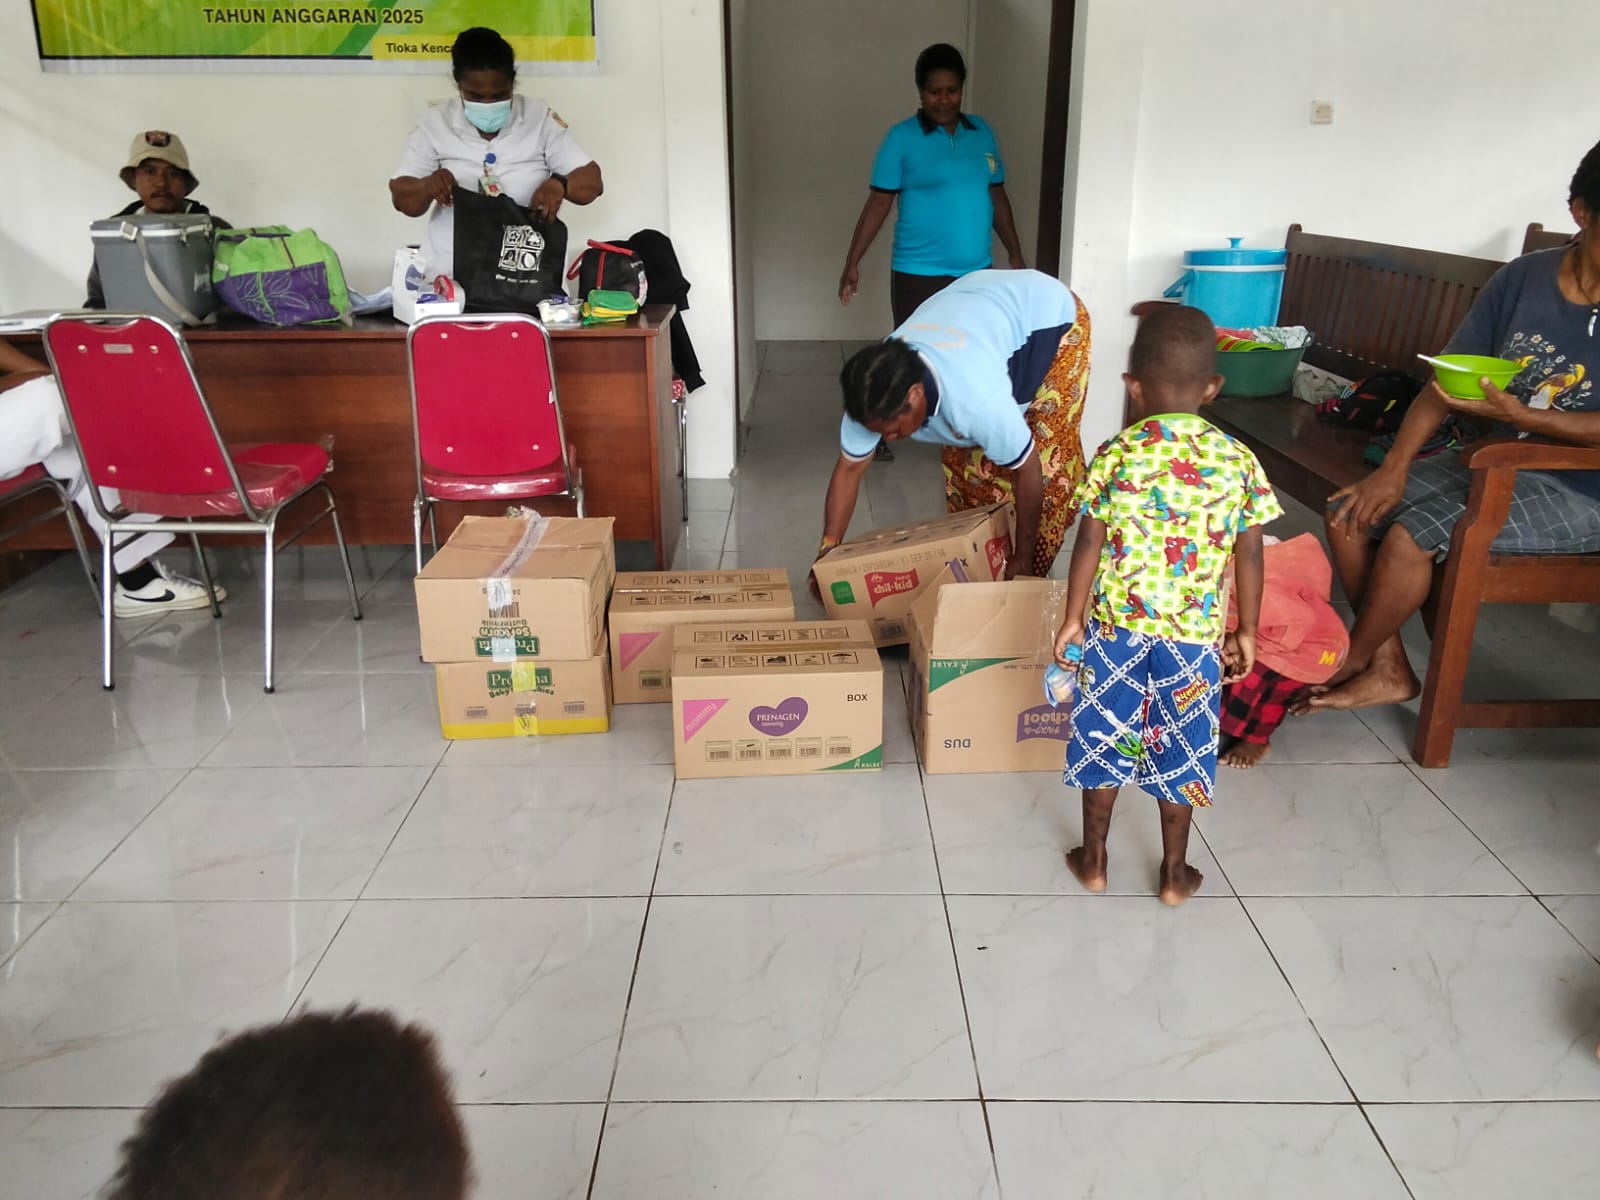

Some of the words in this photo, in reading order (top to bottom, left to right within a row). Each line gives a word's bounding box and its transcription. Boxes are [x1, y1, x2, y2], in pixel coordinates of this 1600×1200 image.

[203, 9, 265, 23] TAHUN
[272, 8, 376, 24] ANGGARAN
[383, 9, 424, 24] 2025
[480, 627, 531, 638] Softcorn
[1318, 650, 1337, 666] M
[847, 694, 868, 702] BOX
[757, 713, 800, 722] PRENAGEN
[1023, 711, 1069, 725] chool
[944, 738, 971, 749] DUS
